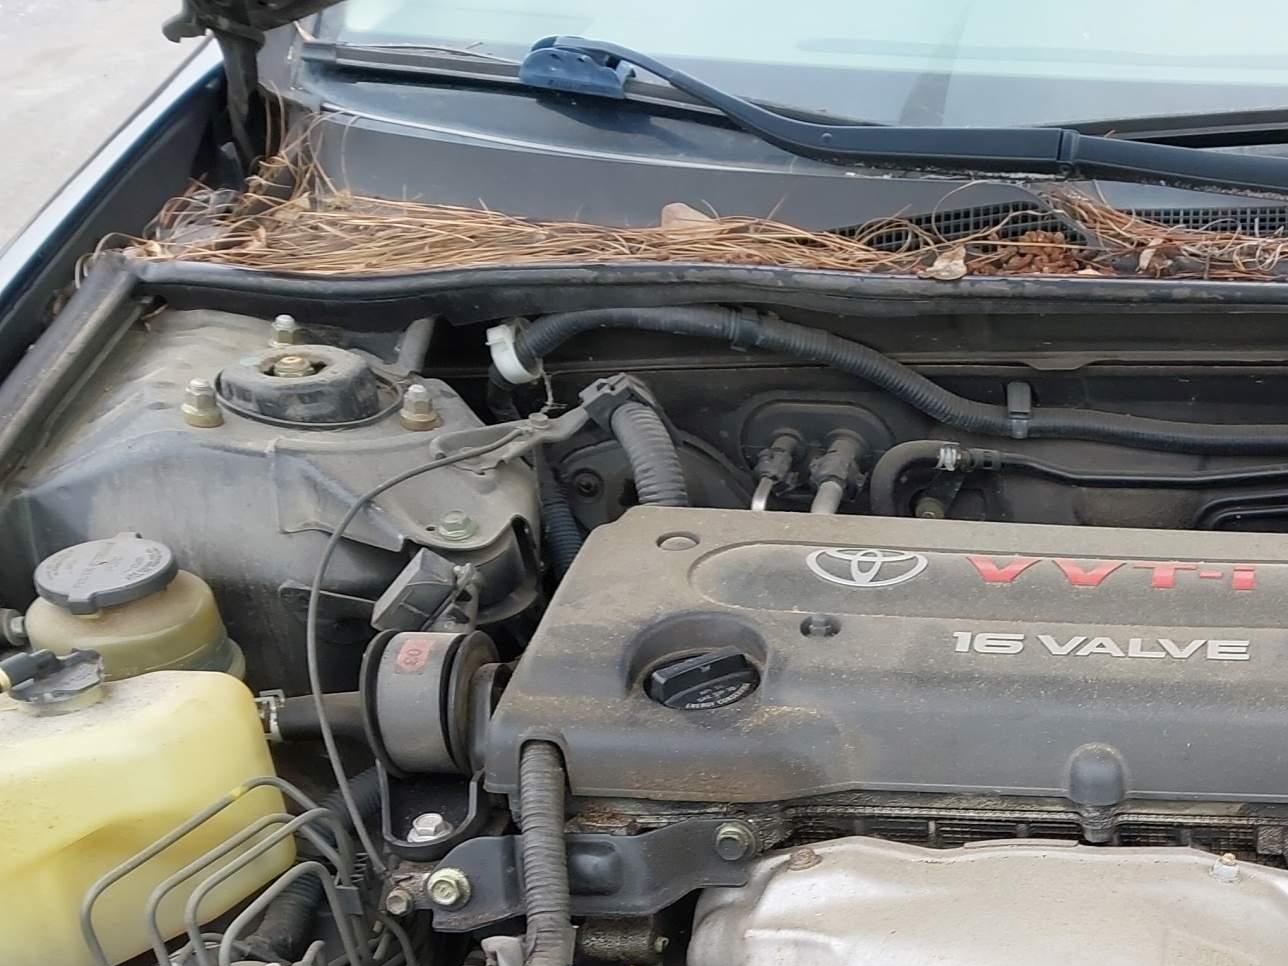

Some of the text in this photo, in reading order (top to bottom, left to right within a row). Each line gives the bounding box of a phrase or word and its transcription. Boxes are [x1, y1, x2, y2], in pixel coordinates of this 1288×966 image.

[966, 555, 1256, 591] VVT-i
[953, 630, 1251, 662] 16 VALVE
